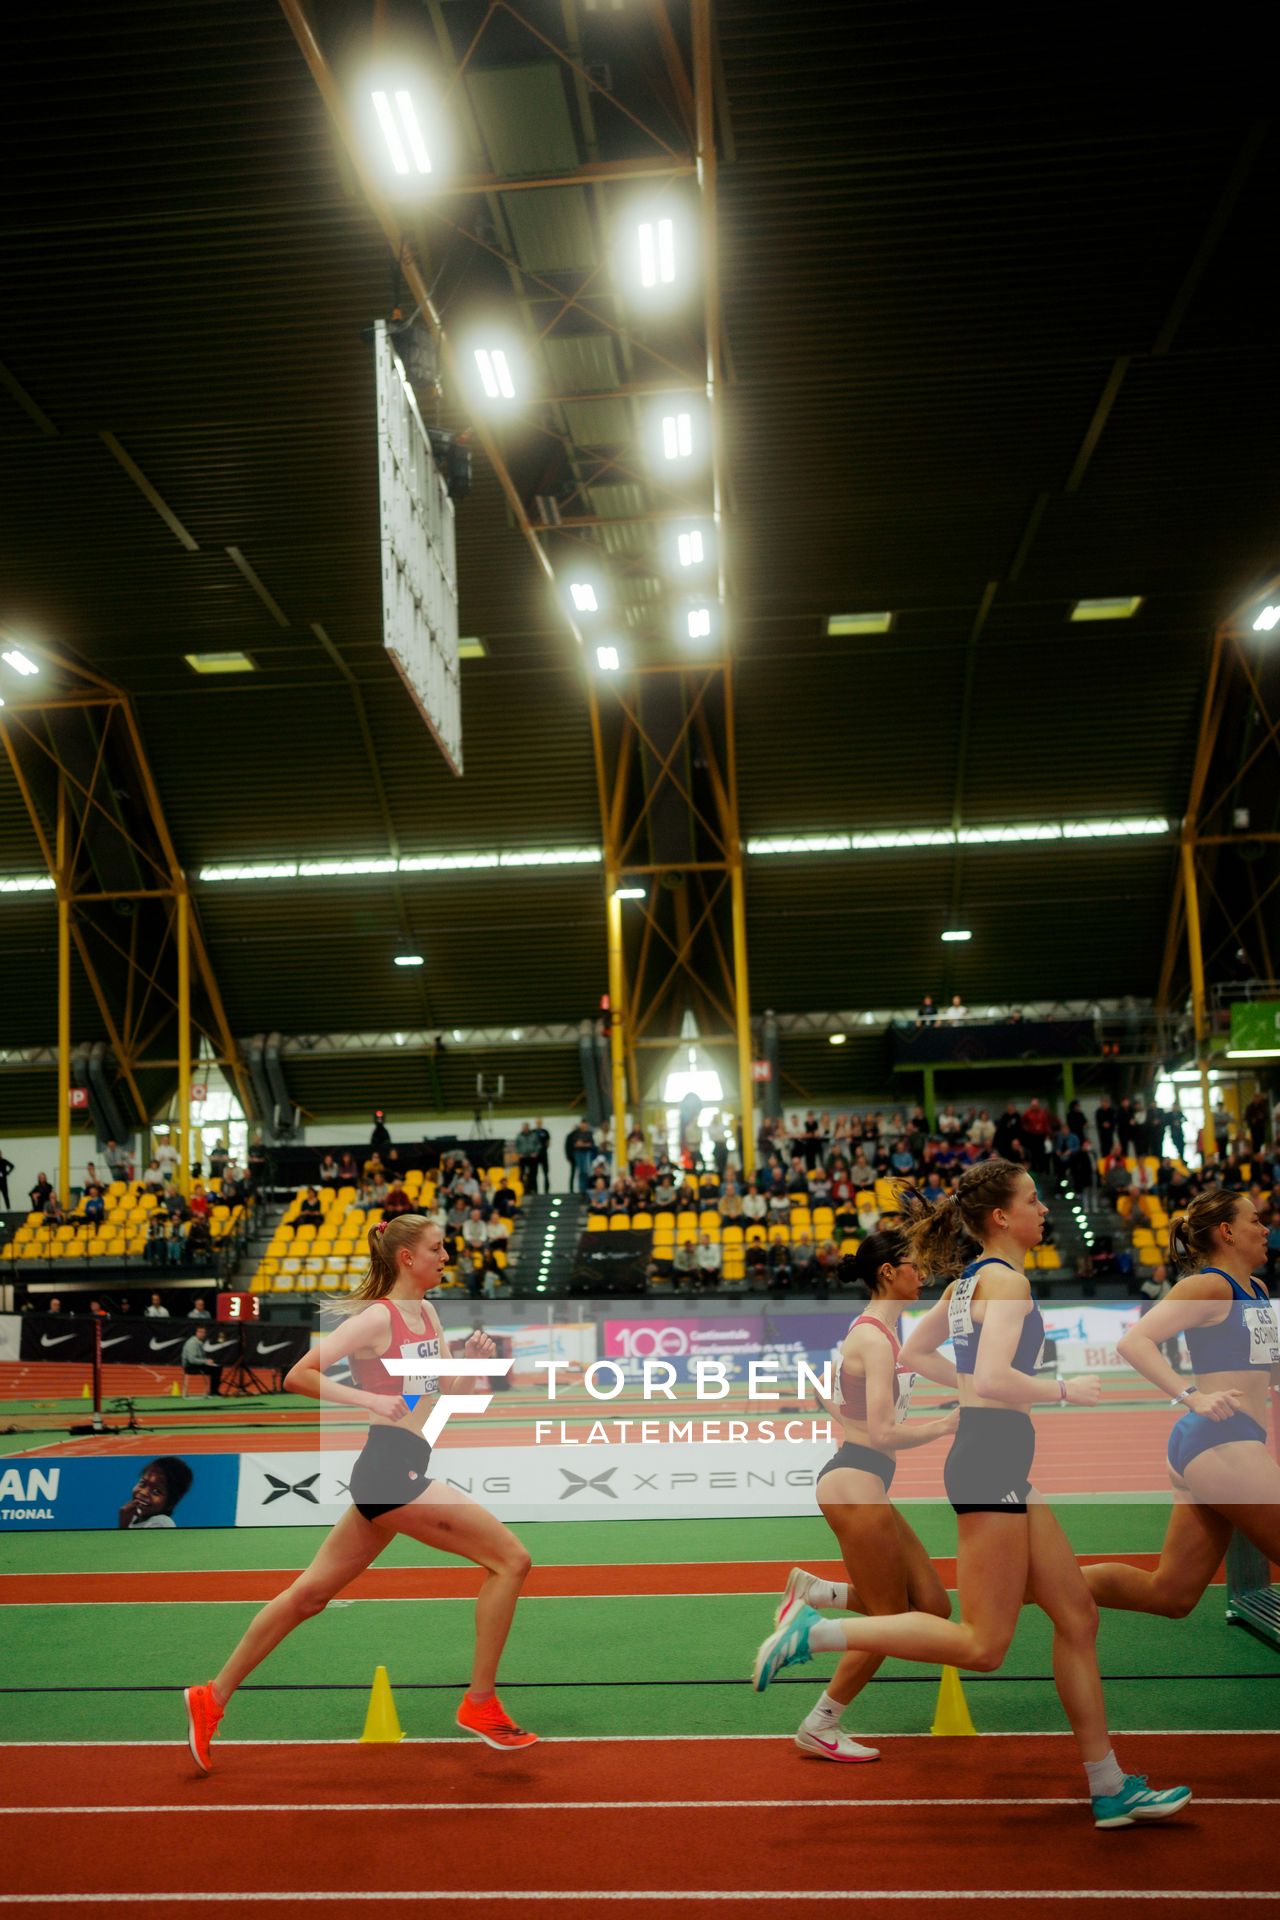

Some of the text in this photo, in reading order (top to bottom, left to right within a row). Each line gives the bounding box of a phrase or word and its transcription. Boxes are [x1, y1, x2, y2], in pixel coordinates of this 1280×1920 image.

[229, 1296, 241, 1317] 3
[417, 1340, 439, 1358] GLS
[615, 1327, 688, 1357] 100
[335, 1477, 511, 1496] XNG
[633, 1470, 815, 1491] XPENG
[0, 1509, 54, 1520] TIONAL
